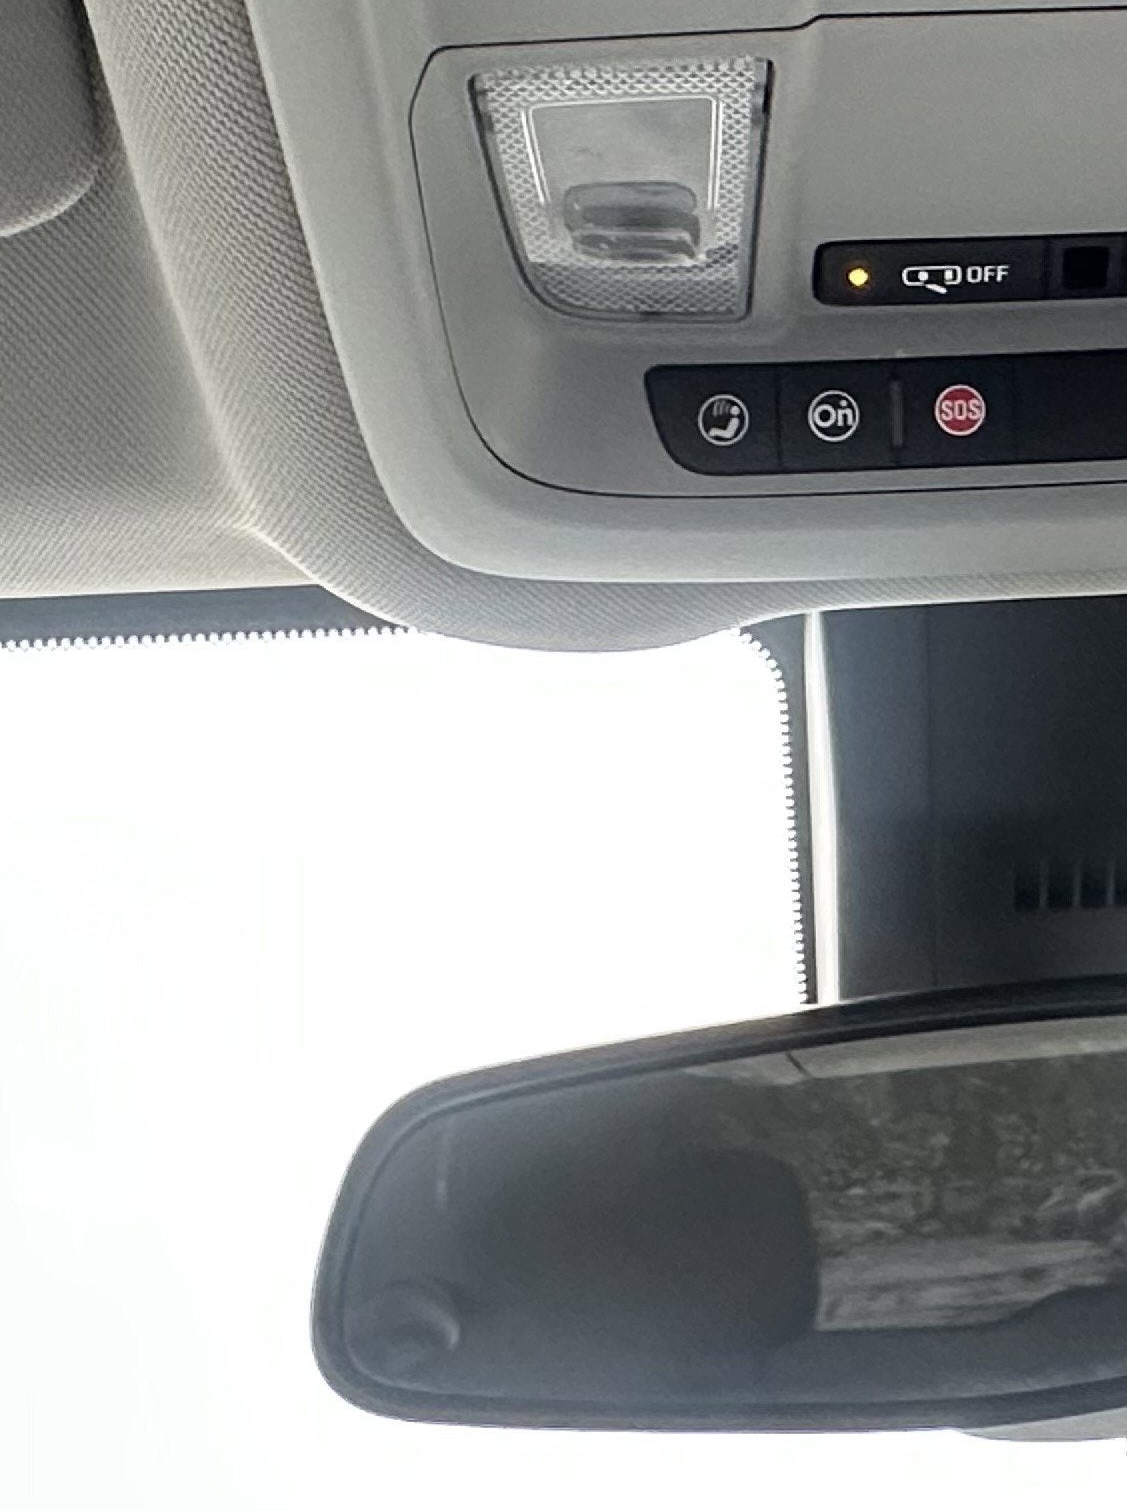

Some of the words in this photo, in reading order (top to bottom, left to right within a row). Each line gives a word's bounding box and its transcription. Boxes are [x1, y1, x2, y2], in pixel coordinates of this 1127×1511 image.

[967, 264, 1010, 284] OFF
[812, 399, 855, 429] On
[940, 399, 982, 422] SOS
